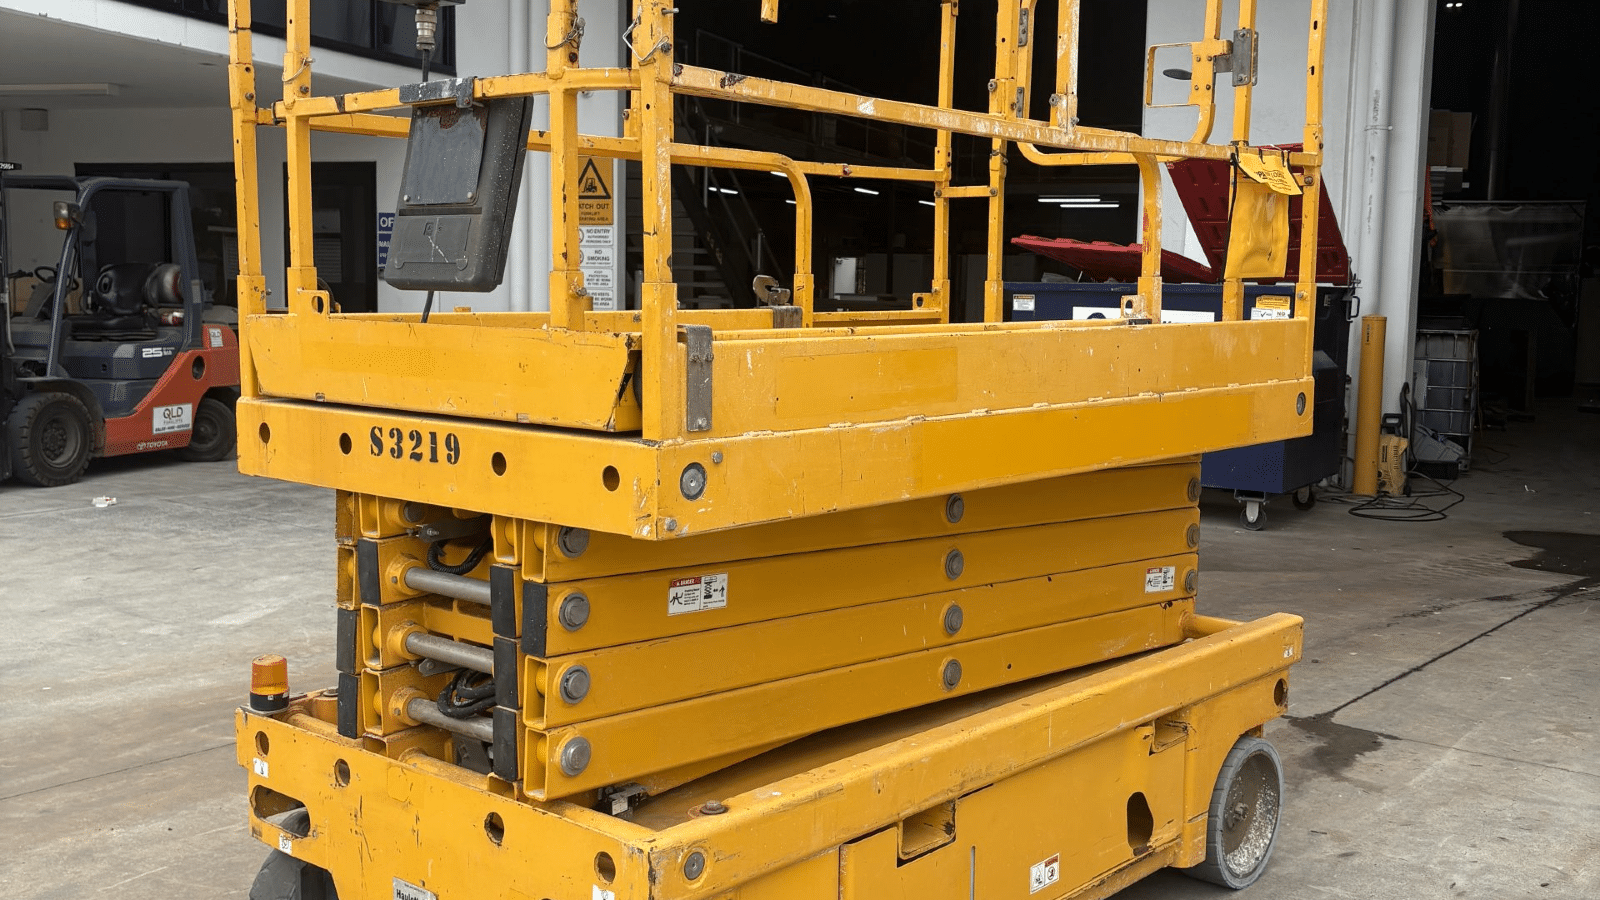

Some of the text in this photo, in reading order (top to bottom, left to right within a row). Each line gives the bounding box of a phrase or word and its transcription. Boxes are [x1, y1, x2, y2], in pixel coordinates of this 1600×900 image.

[142, 347, 163, 358] 25
[163, 406, 183, 420] QLD
[370, 426, 460, 465] S3219
